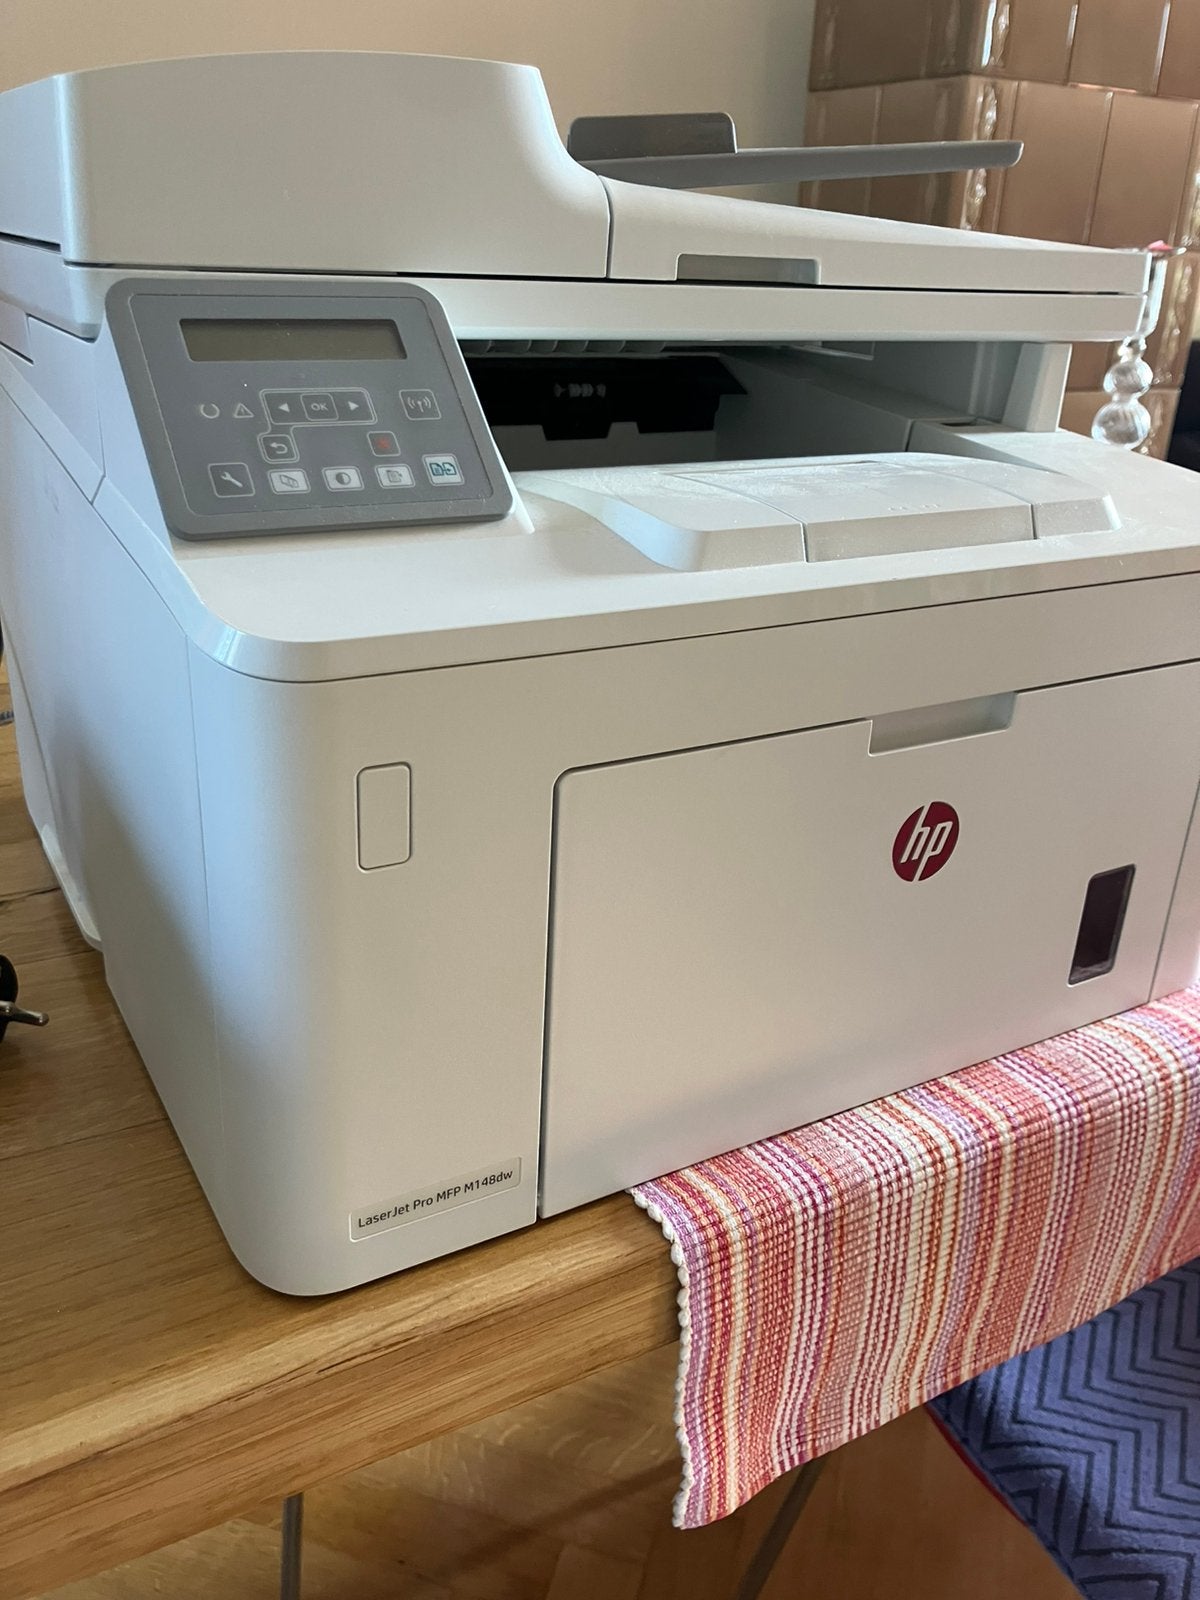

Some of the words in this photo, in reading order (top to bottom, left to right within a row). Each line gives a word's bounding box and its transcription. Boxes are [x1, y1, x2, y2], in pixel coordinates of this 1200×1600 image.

[310, 402, 329, 411] OK
[899, 801, 954, 882] hp
[358, 1204, 410, 1228] LaserJet
[413, 1197, 434, 1210] Pro
[436, 1186, 461, 1203] MFP
[464, 1170, 513, 1193] M148dw
